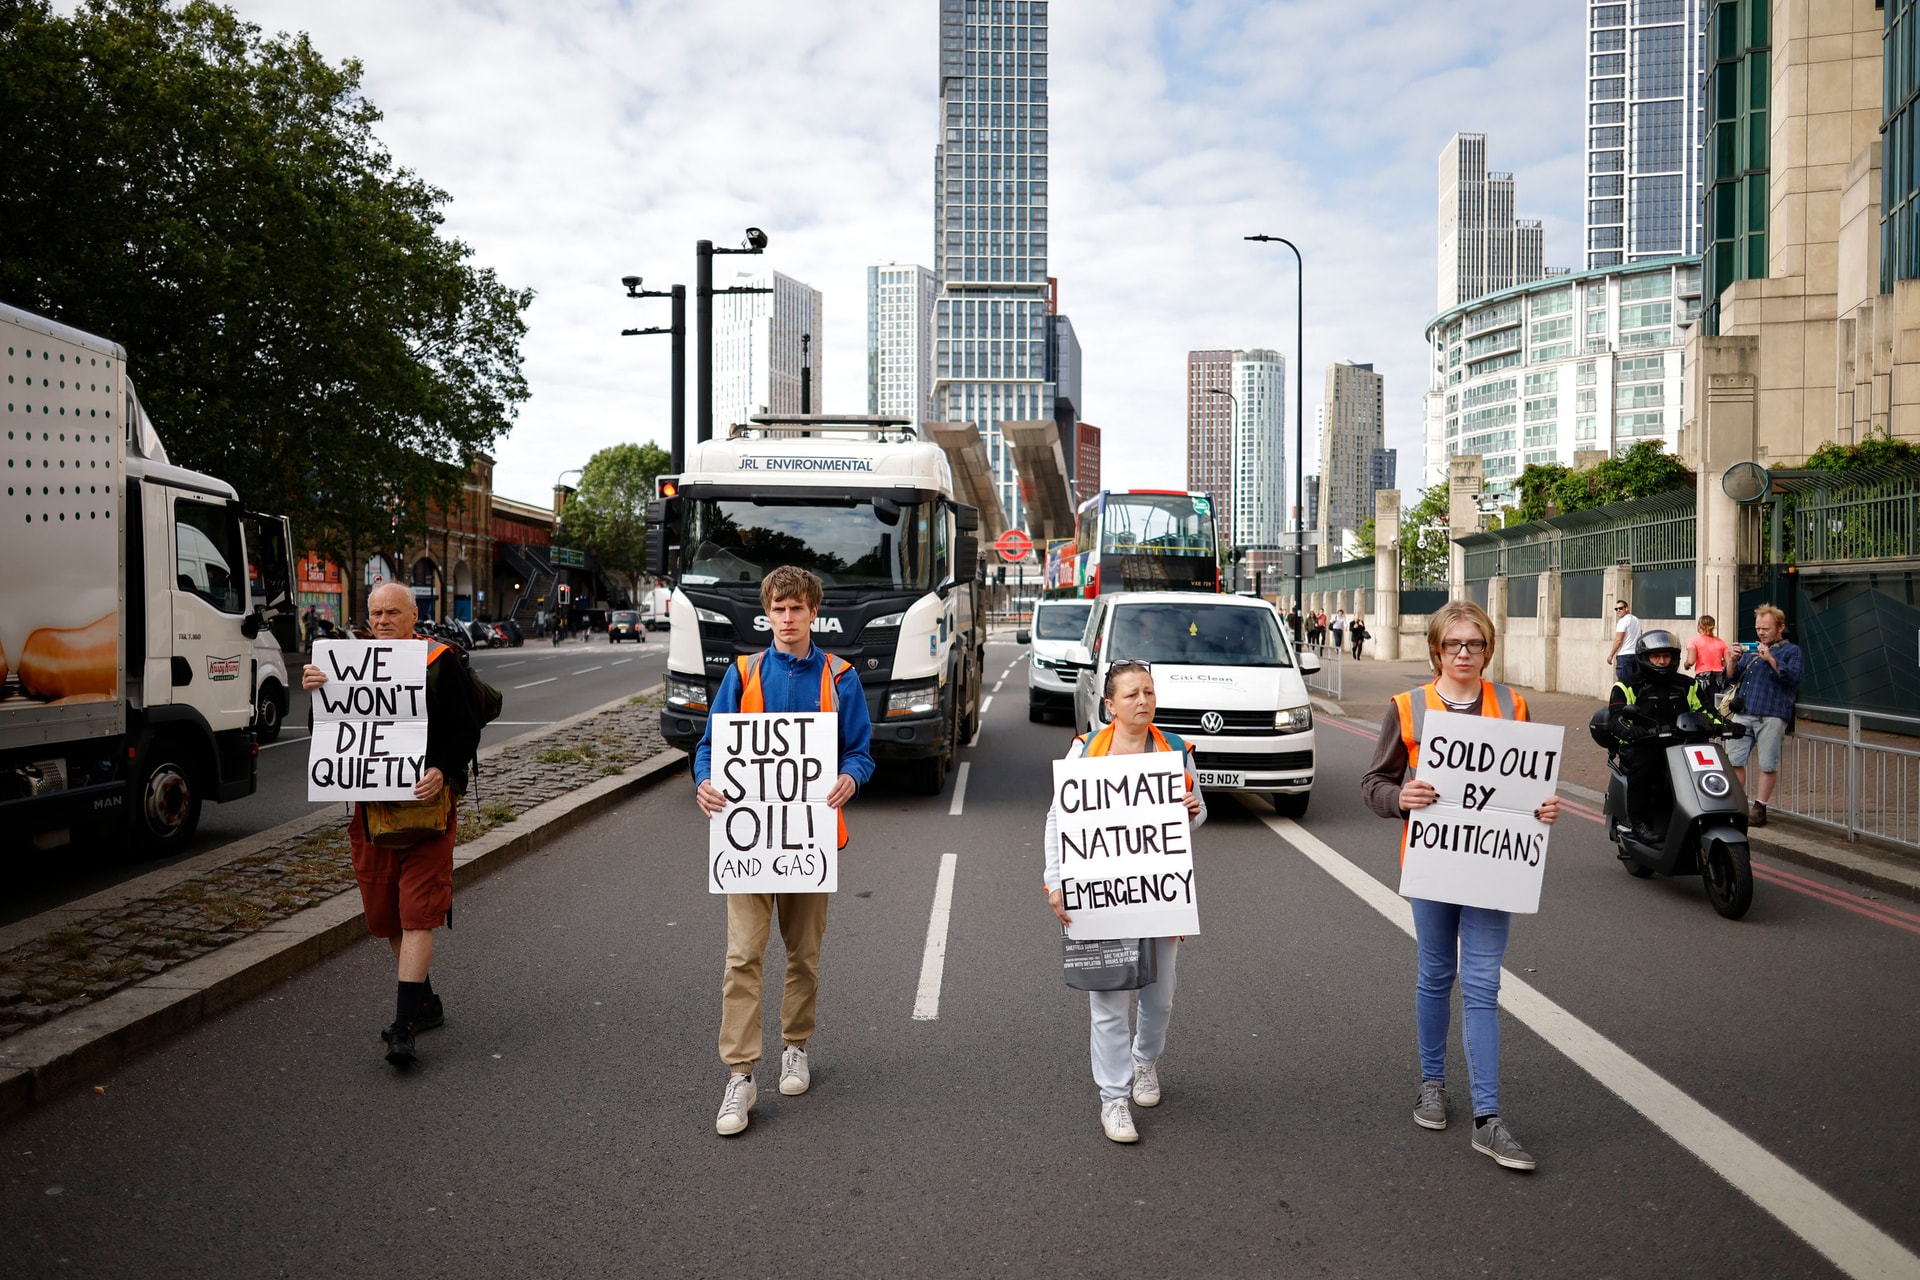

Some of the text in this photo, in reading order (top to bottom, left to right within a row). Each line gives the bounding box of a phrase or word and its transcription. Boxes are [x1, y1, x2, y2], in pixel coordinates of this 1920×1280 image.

[738, 458, 873, 472] JRL ENVIRONMENTAL
[752, 615, 844, 633] SNIA
[328, 647, 393, 682] WE
[1197, 674, 1233, 682] Clean
[319, 684, 424, 717] WON'T
[336, 721, 395, 757] DIE
[726, 718, 815, 757] JUST
[311, 754, 426, 790] QUIETLY
[1427, 736, 1558, 782] SOLD OUT
[1694, 750, 1715, 766] L
[722, 757, 822, 804] STOP
[1060, 771, 1184, 814] CLIMATE
[1196, 773, 1240, 785] 69 NDX
[94, 795, 122, 810] MAN
[1462, 783, 1496, 812] BY
[725, 804, 815, 852] OIL!
[1061, 821, 1187, 864] NATURE
[1409, 820, 1544, 867] POLITICIANS
[712, 847, 828, 891] (AND GAS)
[1060, 868, 1193, 911] EMERGENCY
